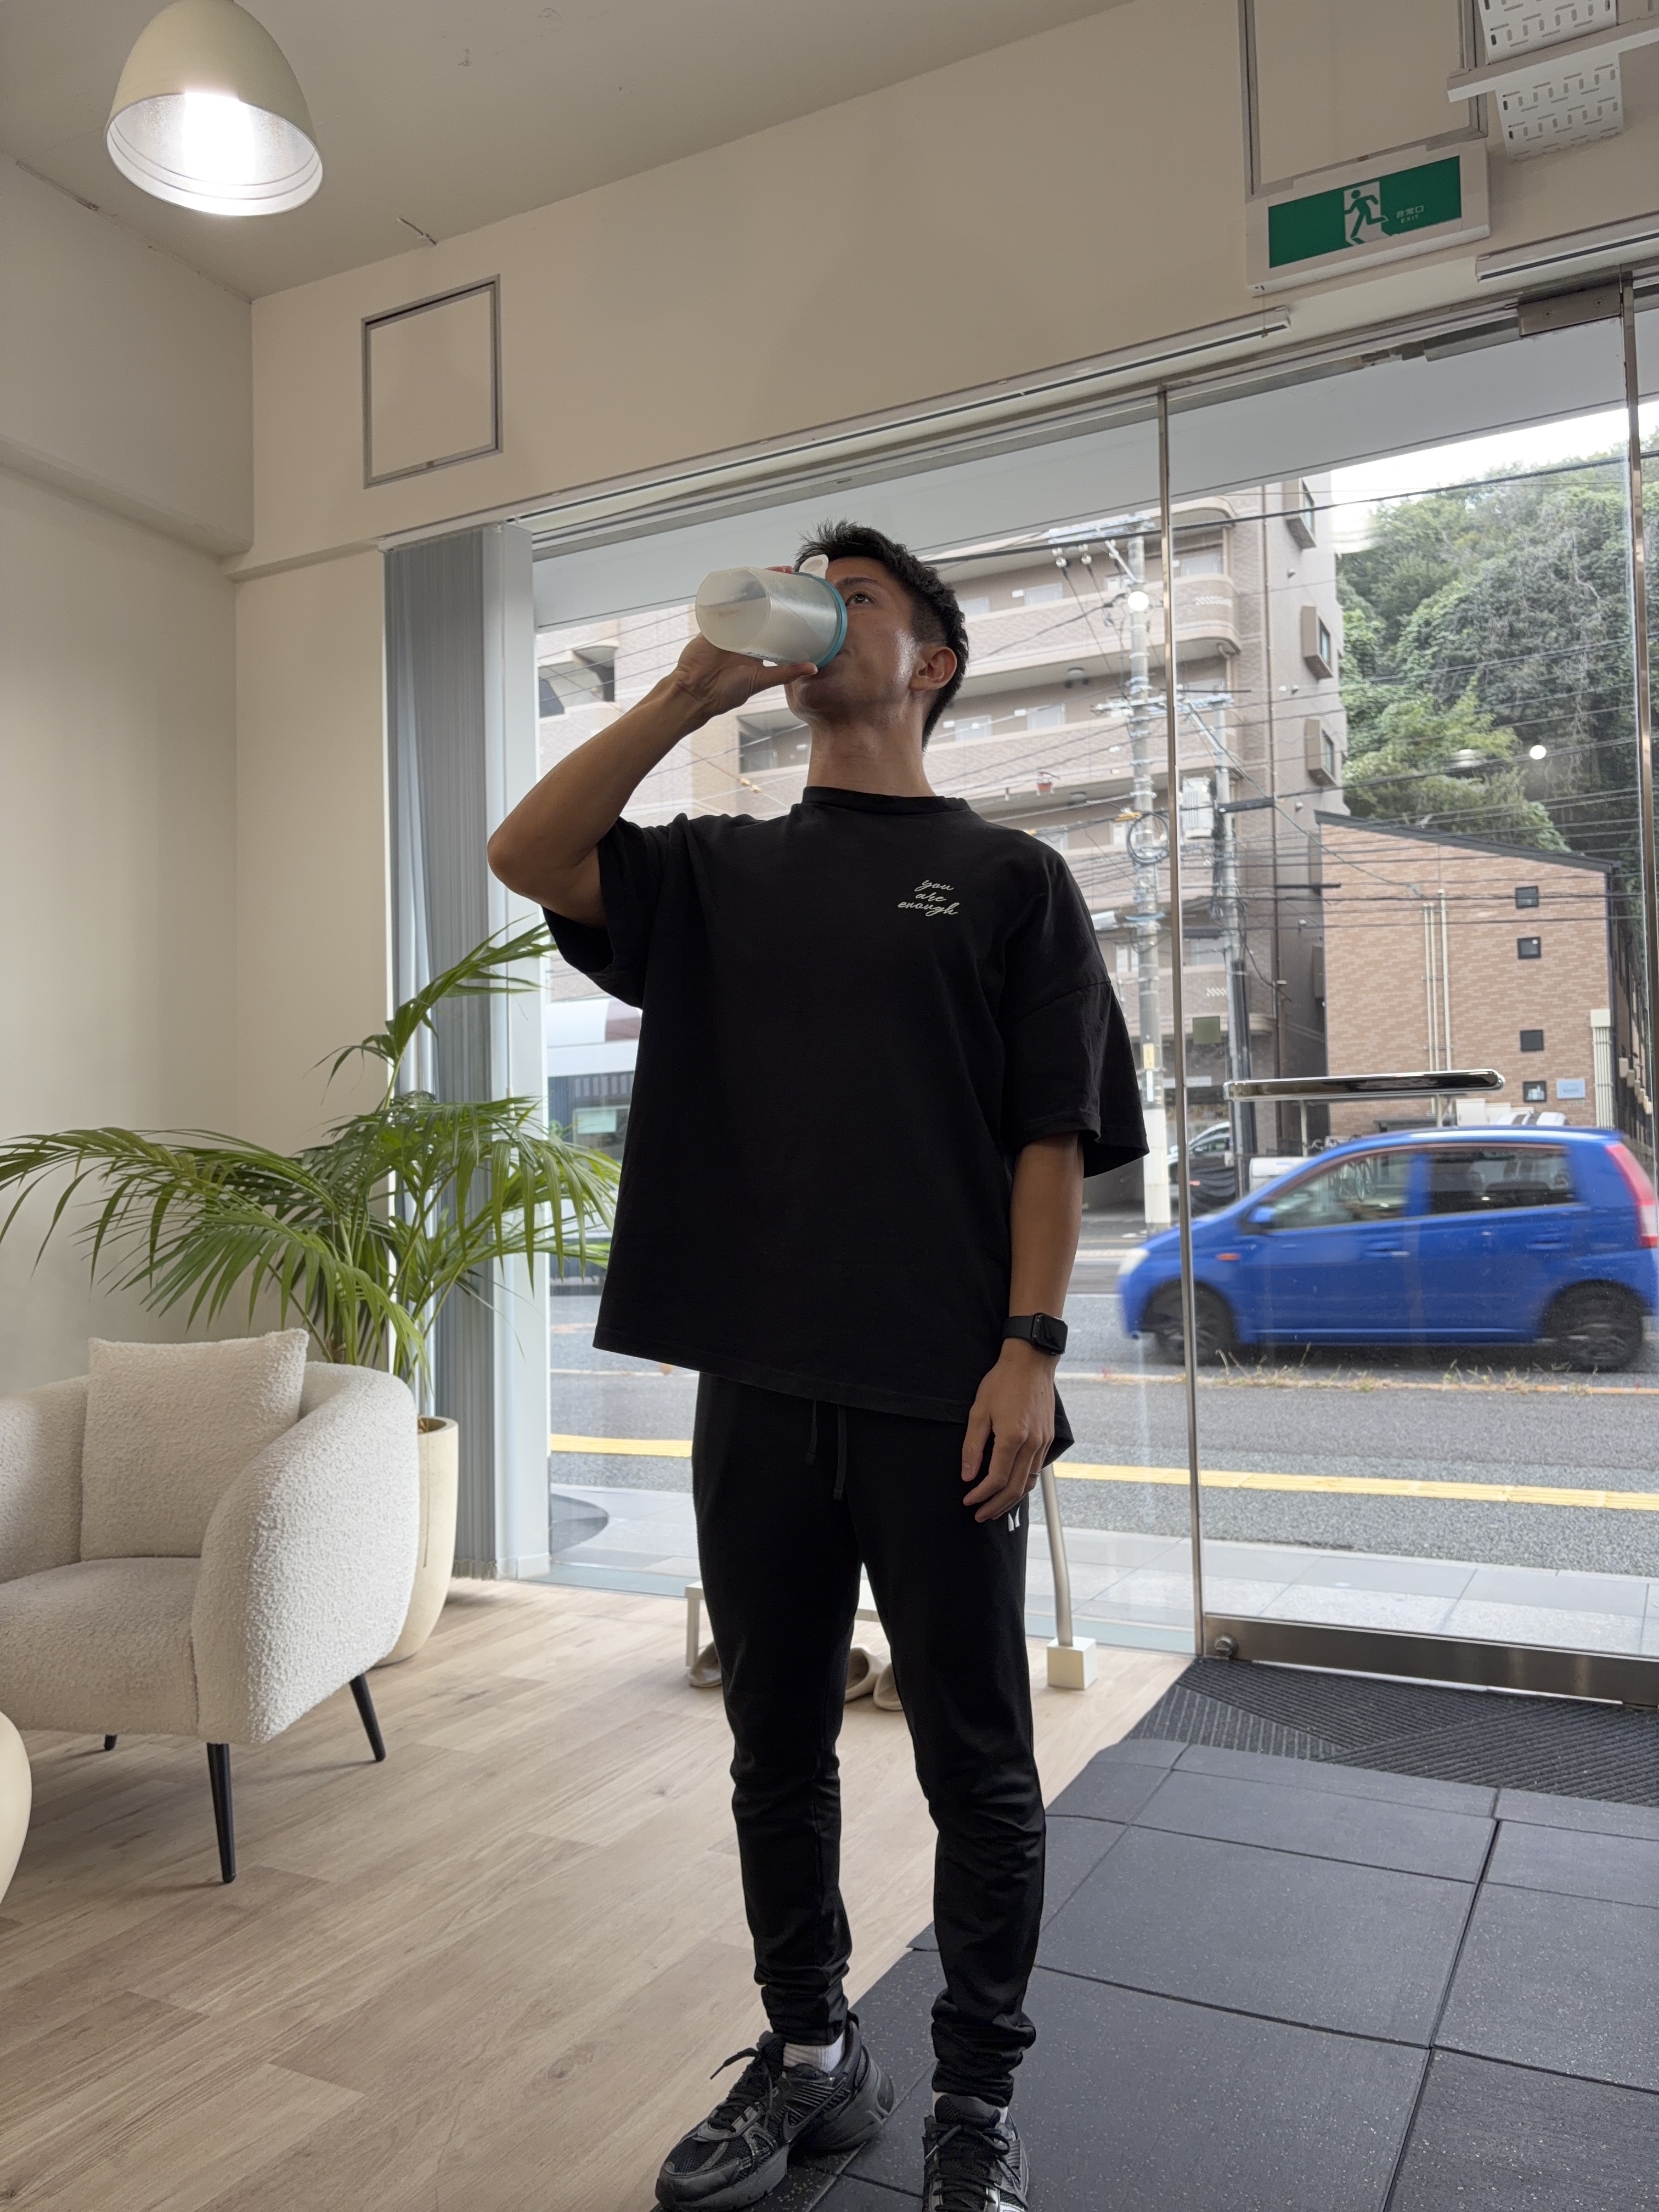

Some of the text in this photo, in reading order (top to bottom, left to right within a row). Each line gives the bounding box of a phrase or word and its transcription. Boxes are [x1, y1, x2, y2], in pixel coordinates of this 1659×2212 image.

[1396, 205, 1424, 218] 非常口
[914, 879, 954, 891] you
[915, 891, 946, 902] are
[898, 901, 960, 917] enough
